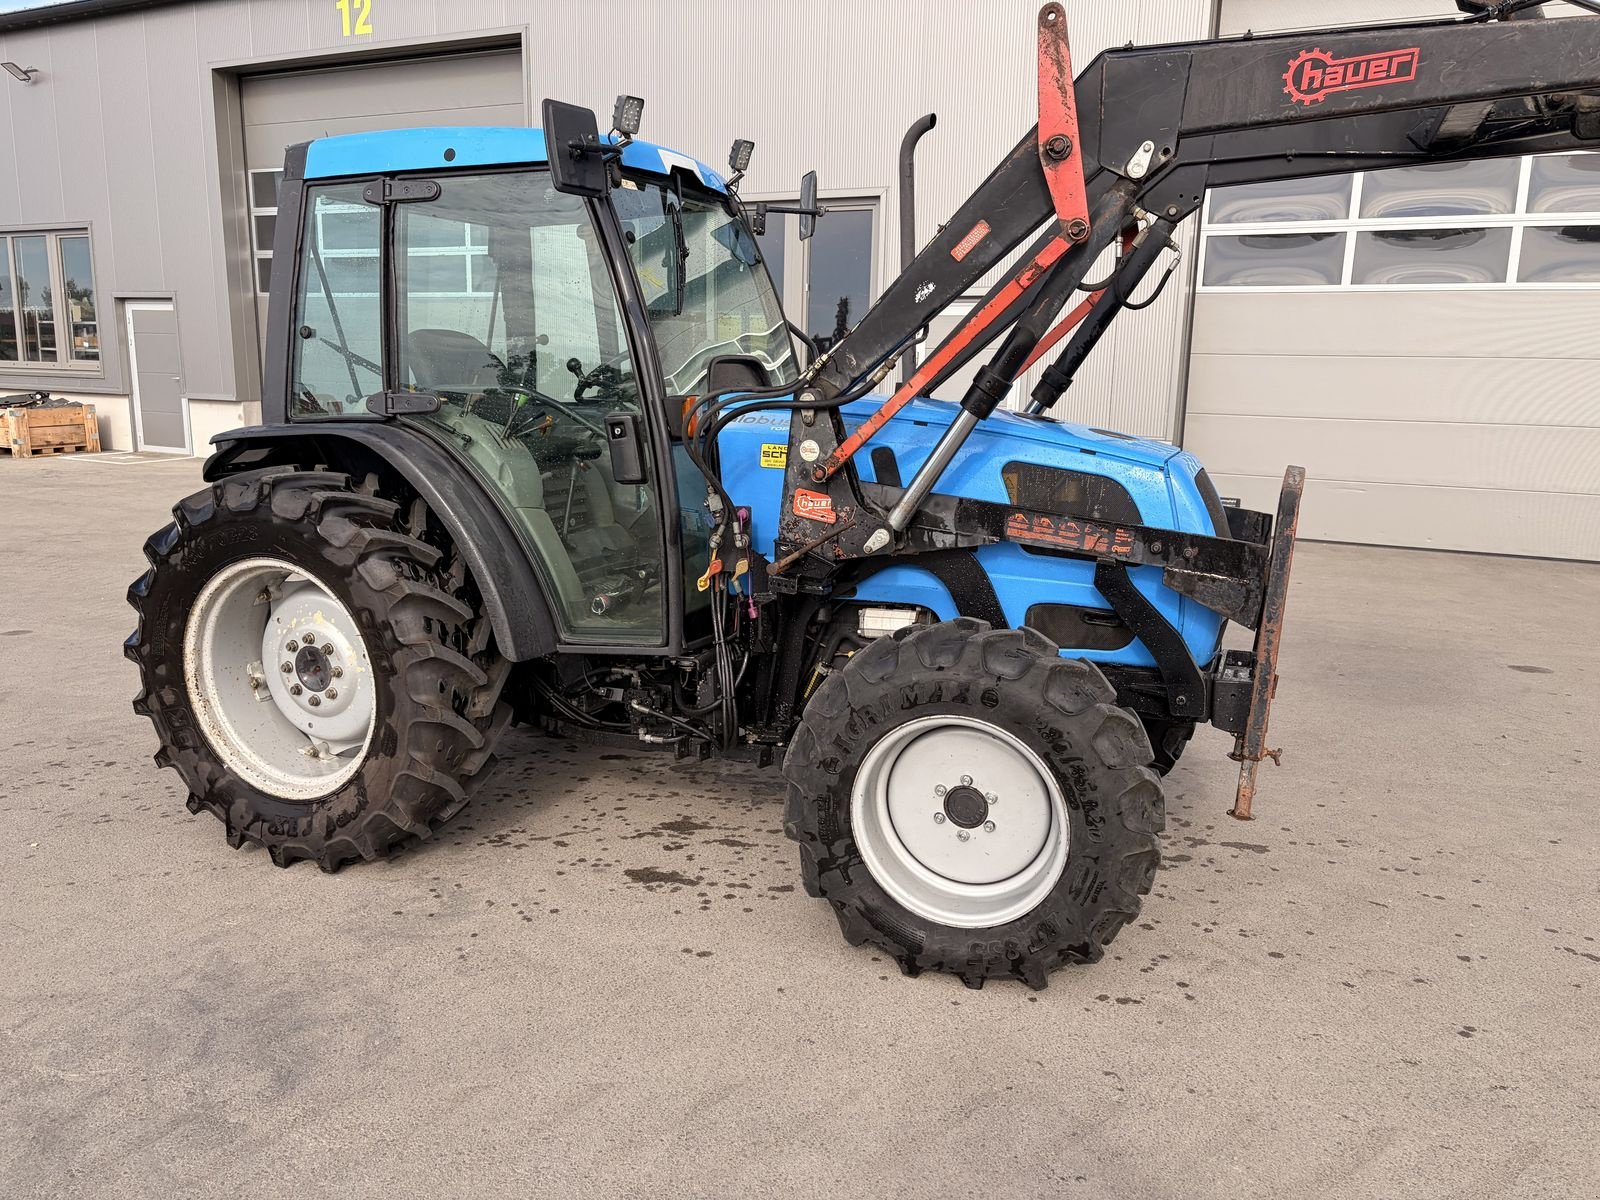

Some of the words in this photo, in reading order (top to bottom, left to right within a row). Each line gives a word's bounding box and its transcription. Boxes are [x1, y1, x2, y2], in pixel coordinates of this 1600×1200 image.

[335, 0, 373, 37] 12
[1299, 54, 1413, 91] hauer
[732, 415, 790, 427] lobus
